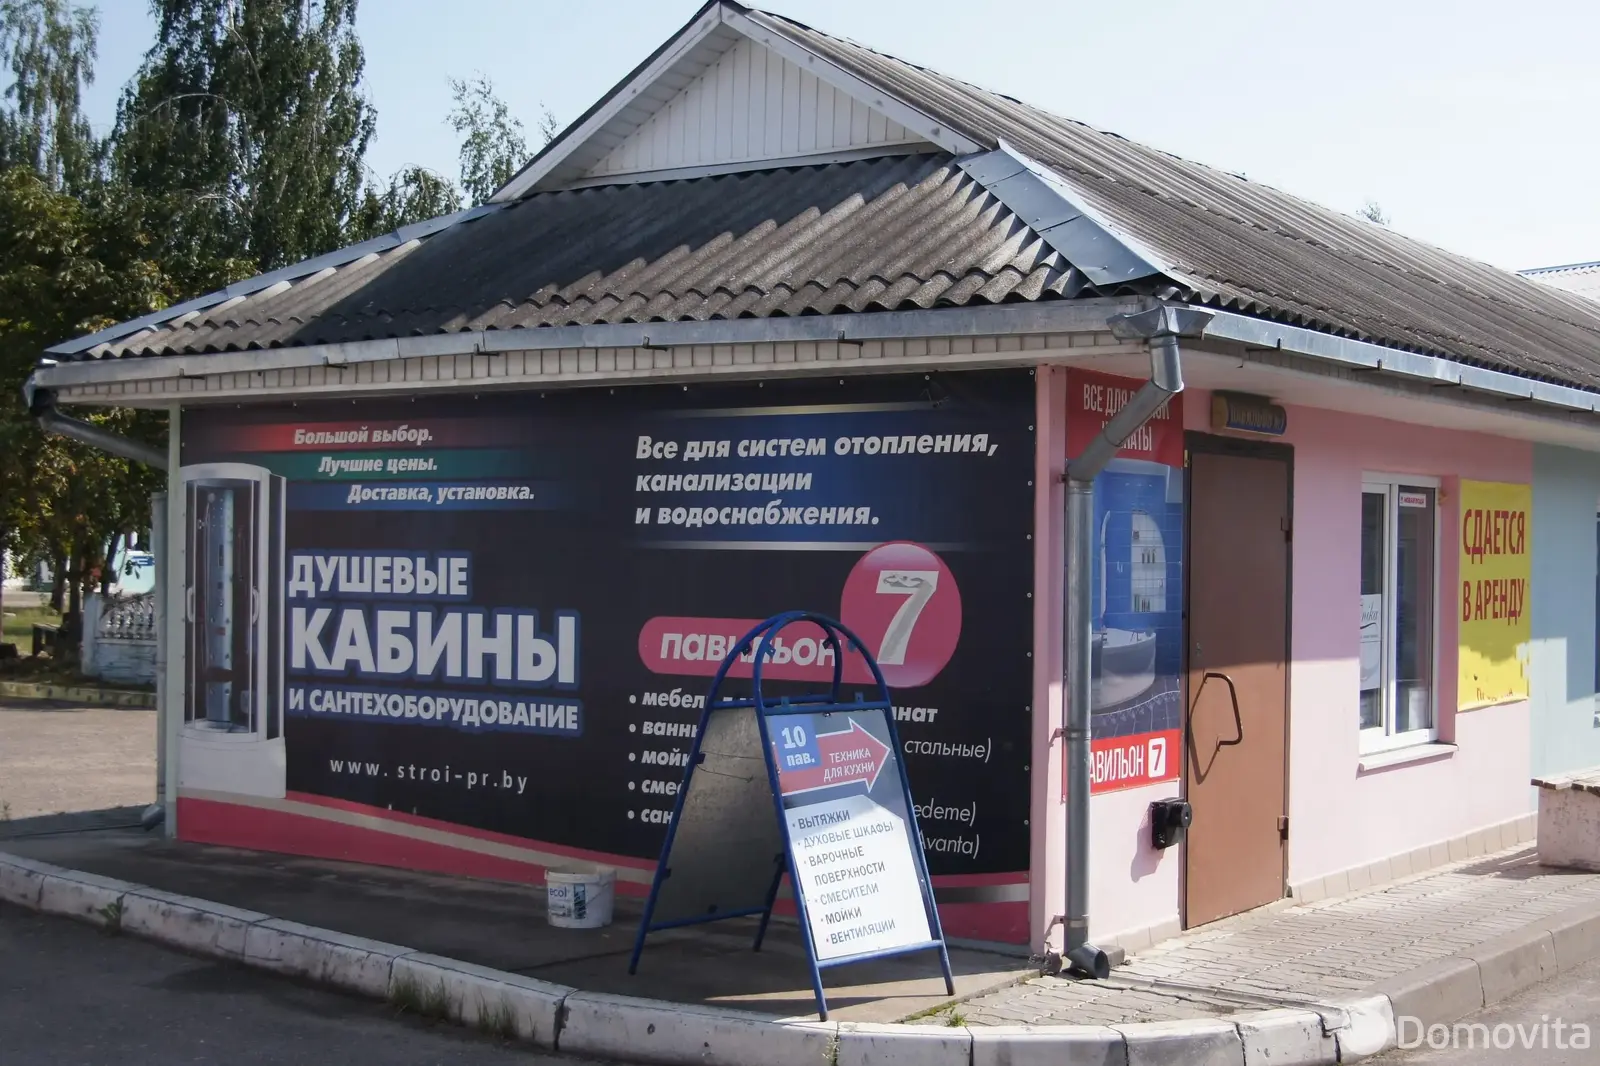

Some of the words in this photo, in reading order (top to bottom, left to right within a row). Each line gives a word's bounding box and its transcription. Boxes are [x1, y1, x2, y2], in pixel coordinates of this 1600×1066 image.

[1083, 383, 1103, 412] ВСЕ
[294, 426, 368, 445] Большой
[372, 424, 433, 446] выбор.
[636, 435, 678, 459] Все
[683, 439, 731, 462] для
[737, 437, 826, 457] систем
[834, 433, 999, 458] отопления,
[318, 456, 383, 477] Лучшие
[387, 457, 438, 474] цены.
[347, 484, 433, 504] Доставка,
[436, 485, 535, 505] установка.
[636, 471, 812, 494] канализации
[635, 507, 650, 524] и
[657, 499, 879, 527] водоснабжения.
[1462, 508, 1525, 564] СДАЕТСЯ
[288, 555, 469, 598] ДУШЕВЫЕ
[1462, 580, 1470, 622] В
[1474, 578, 1525, 625] АРЕНДУ
[875, 570, 939, 666] 7
[292, 607, 575, 684] КАБИНЫ
[288, 689, 305, 711] И
[309, 689, 578, 730] САНТЕХОБОРУДОВАНИЕ
[641, 687, 709, 709] мебел
[781, 725, 807, 749] 10
[641, 747, 691, 767] мойк
[786, 752, 816, 767] пав.
[829, 747, 871, 764] ТЕХНИКА
[904, 737, 992, 764] стальные)
[1089, 744, 1145, 784] АВИЛЬОН
[1151, 743, 1162, 771] 7
[823, 766, 843, 783] ДЛЯ
[845, 761, 875, 777] КУХНИ
[797, 809, 851, 830] ВЫТЯЖКИ
[913, 797, 976, 827] edeme)
[803, 829, 850, 849] ДУХОВЫЕ
[852, 821, 894, 838] ШКАФЫ
[808, 845, 865, 867] ВАРОЧНЫЕ
[814, 861, 886, 887] ПОВЕРХНОСТИ
[819, 882, 880, 906] СМЕСИТЕЛИ
[825, 906, 862, 925] МОЙКИ
[830, 919, 896, 945] ВЕНТИЛЯЦИИ
